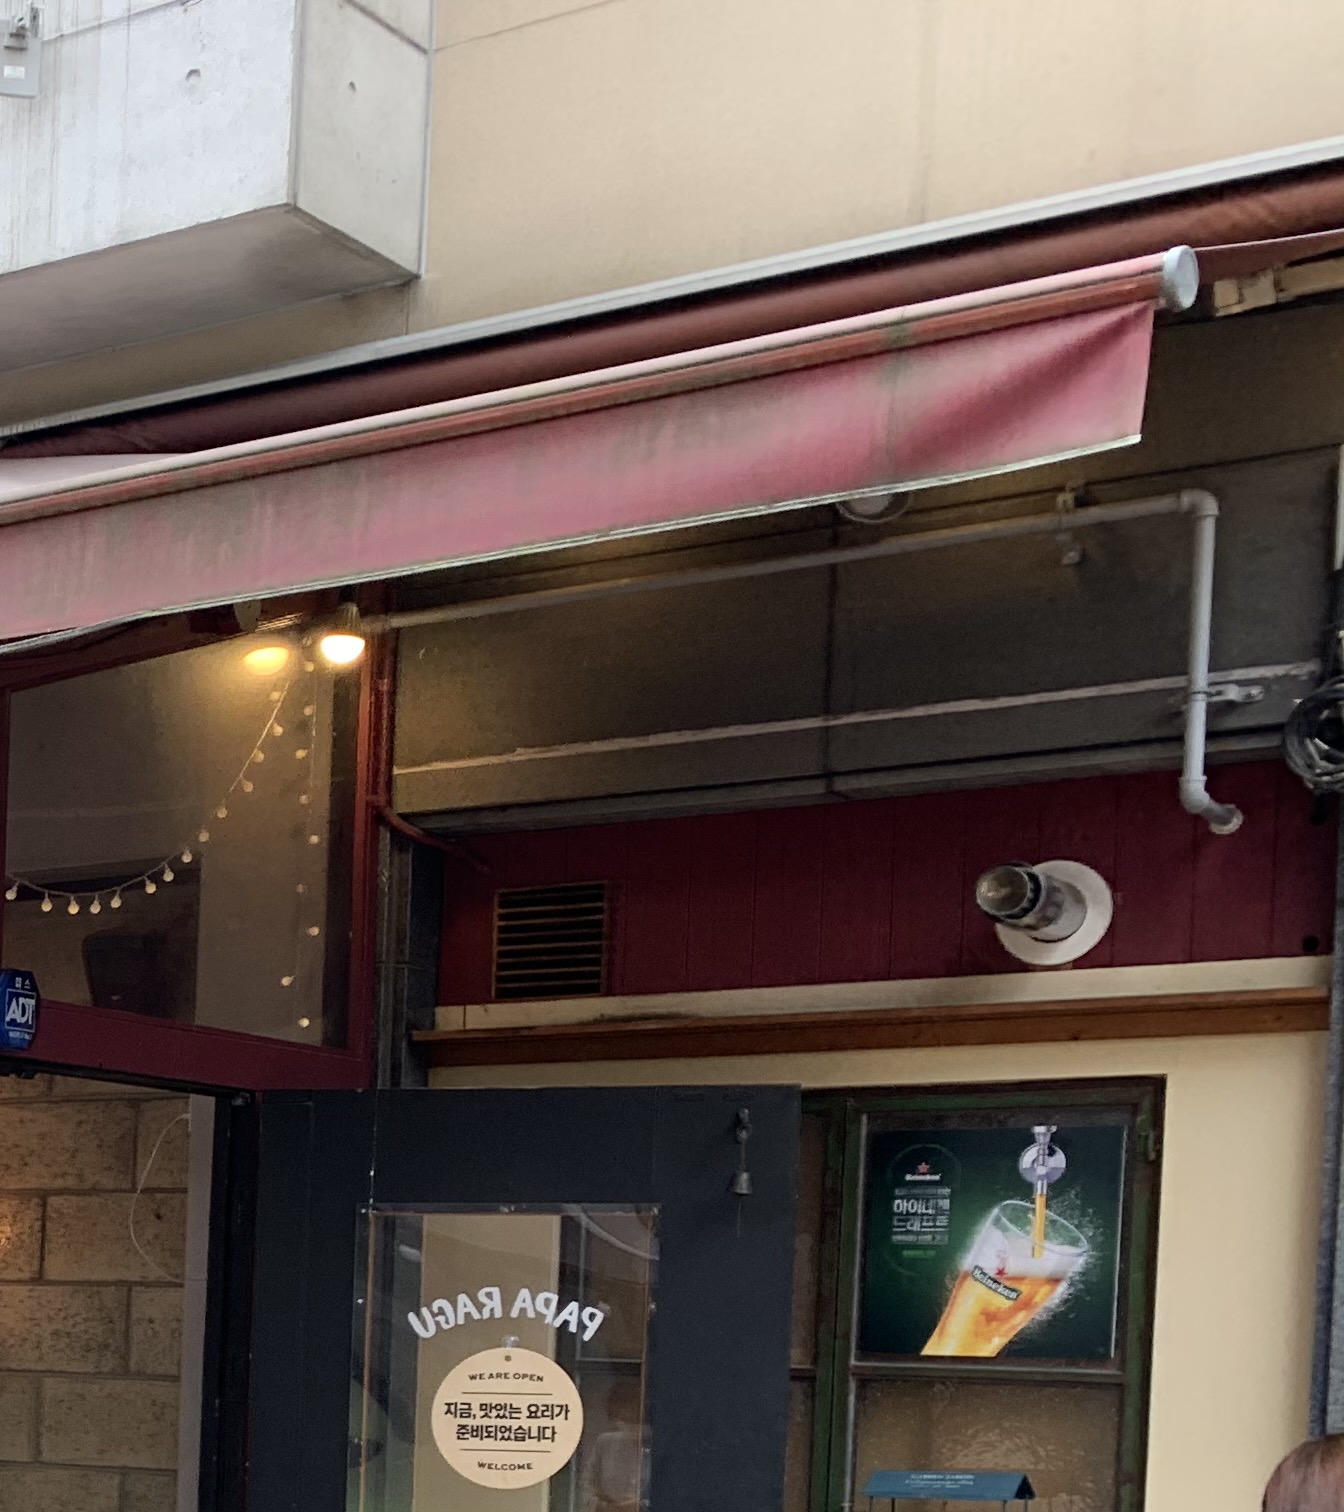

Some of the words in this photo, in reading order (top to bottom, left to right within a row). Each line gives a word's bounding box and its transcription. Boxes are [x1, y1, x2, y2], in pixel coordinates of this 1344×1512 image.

[5, 996, 35, 1025] ADT
[468, 1373, 486, 1382] WE
[488, 1372, 510, 1381] ARE
[512, 1372, 545, 1383] OPEN
[443, 1402, 476, 1420] 지금,
[479, 1402, 522, 1420] 맛있는
[526, 1403, 570, 1421] 요리가
[455, 1424, 557, 1442] 준비되었습니다
[477, 1461, 534, 1471] WELCOME
